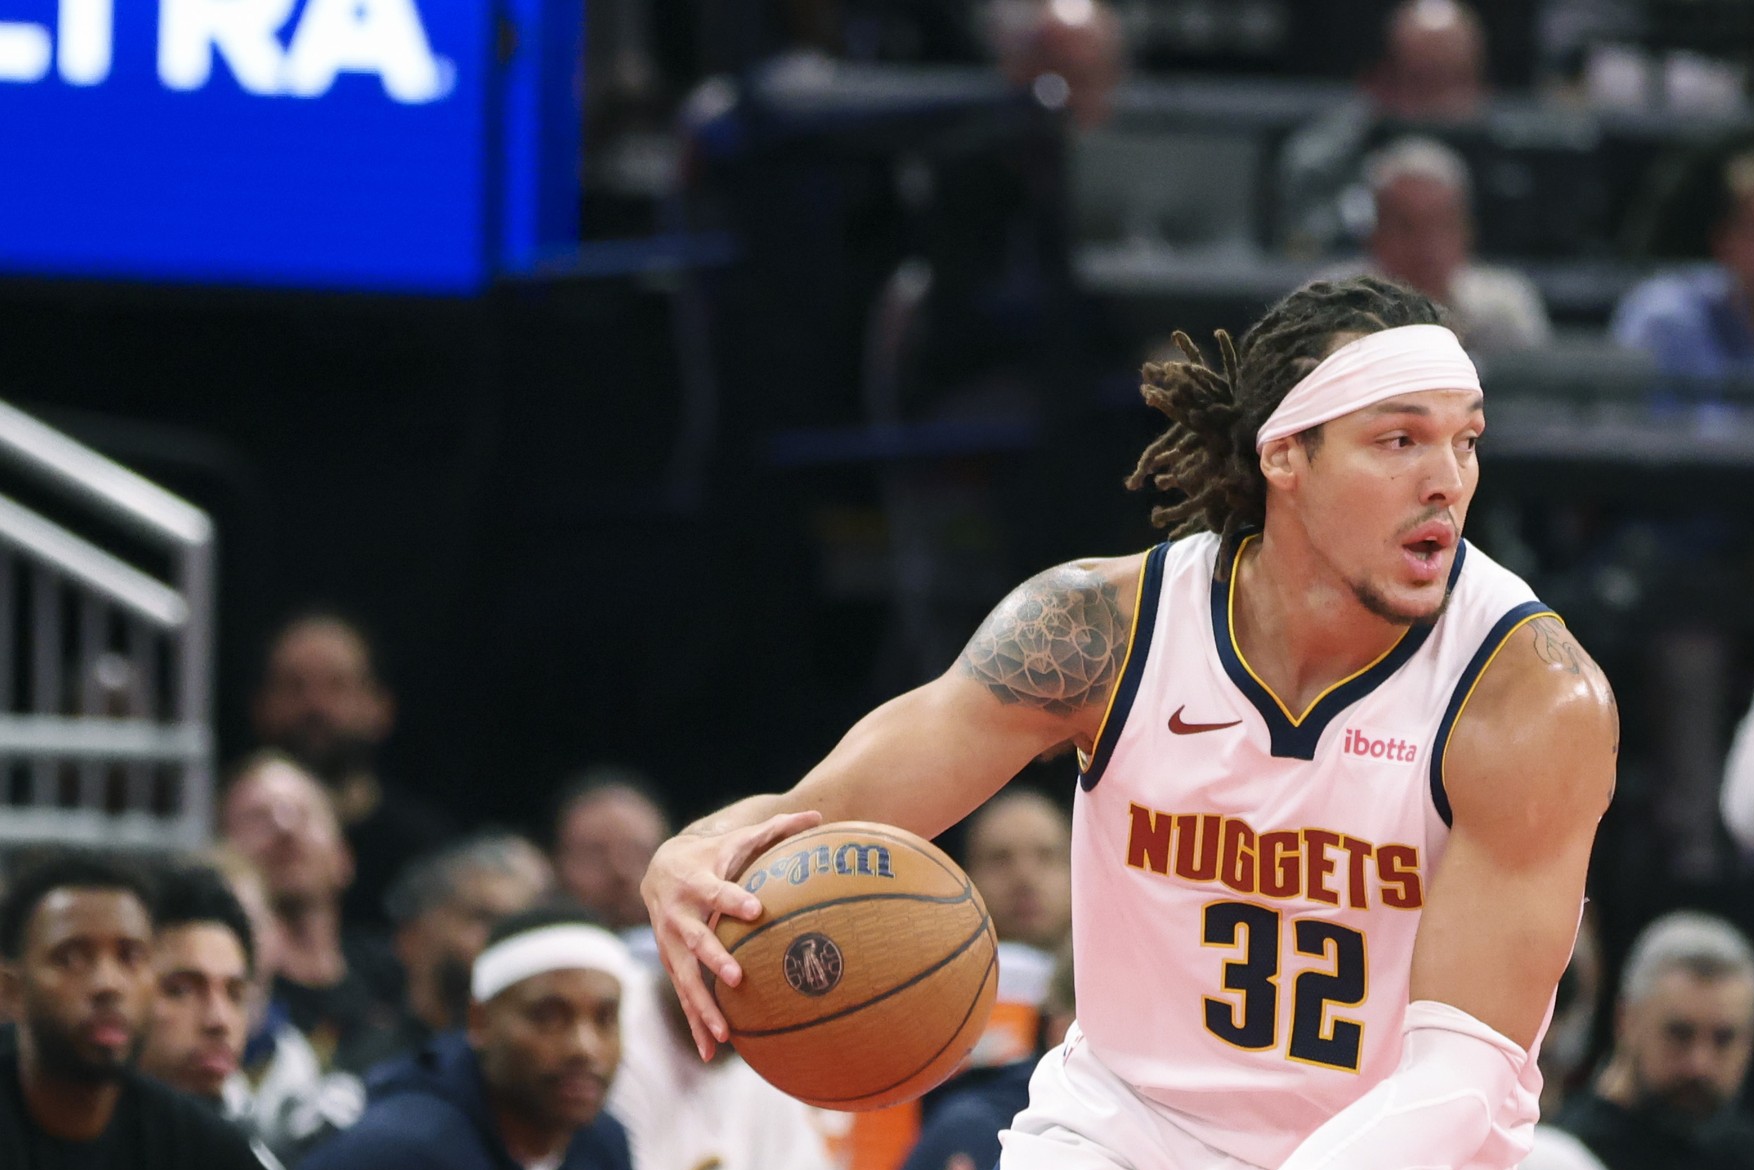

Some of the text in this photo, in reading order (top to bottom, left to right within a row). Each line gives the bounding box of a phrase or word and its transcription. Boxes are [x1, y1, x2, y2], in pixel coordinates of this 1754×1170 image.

[1344, 728, 1418, 763] ibotta
[745, 842, 896, 893] Wilso
[1125, 801, 1425, 910] NUGGETS
[1200, 899, 1370, 1075] 32
